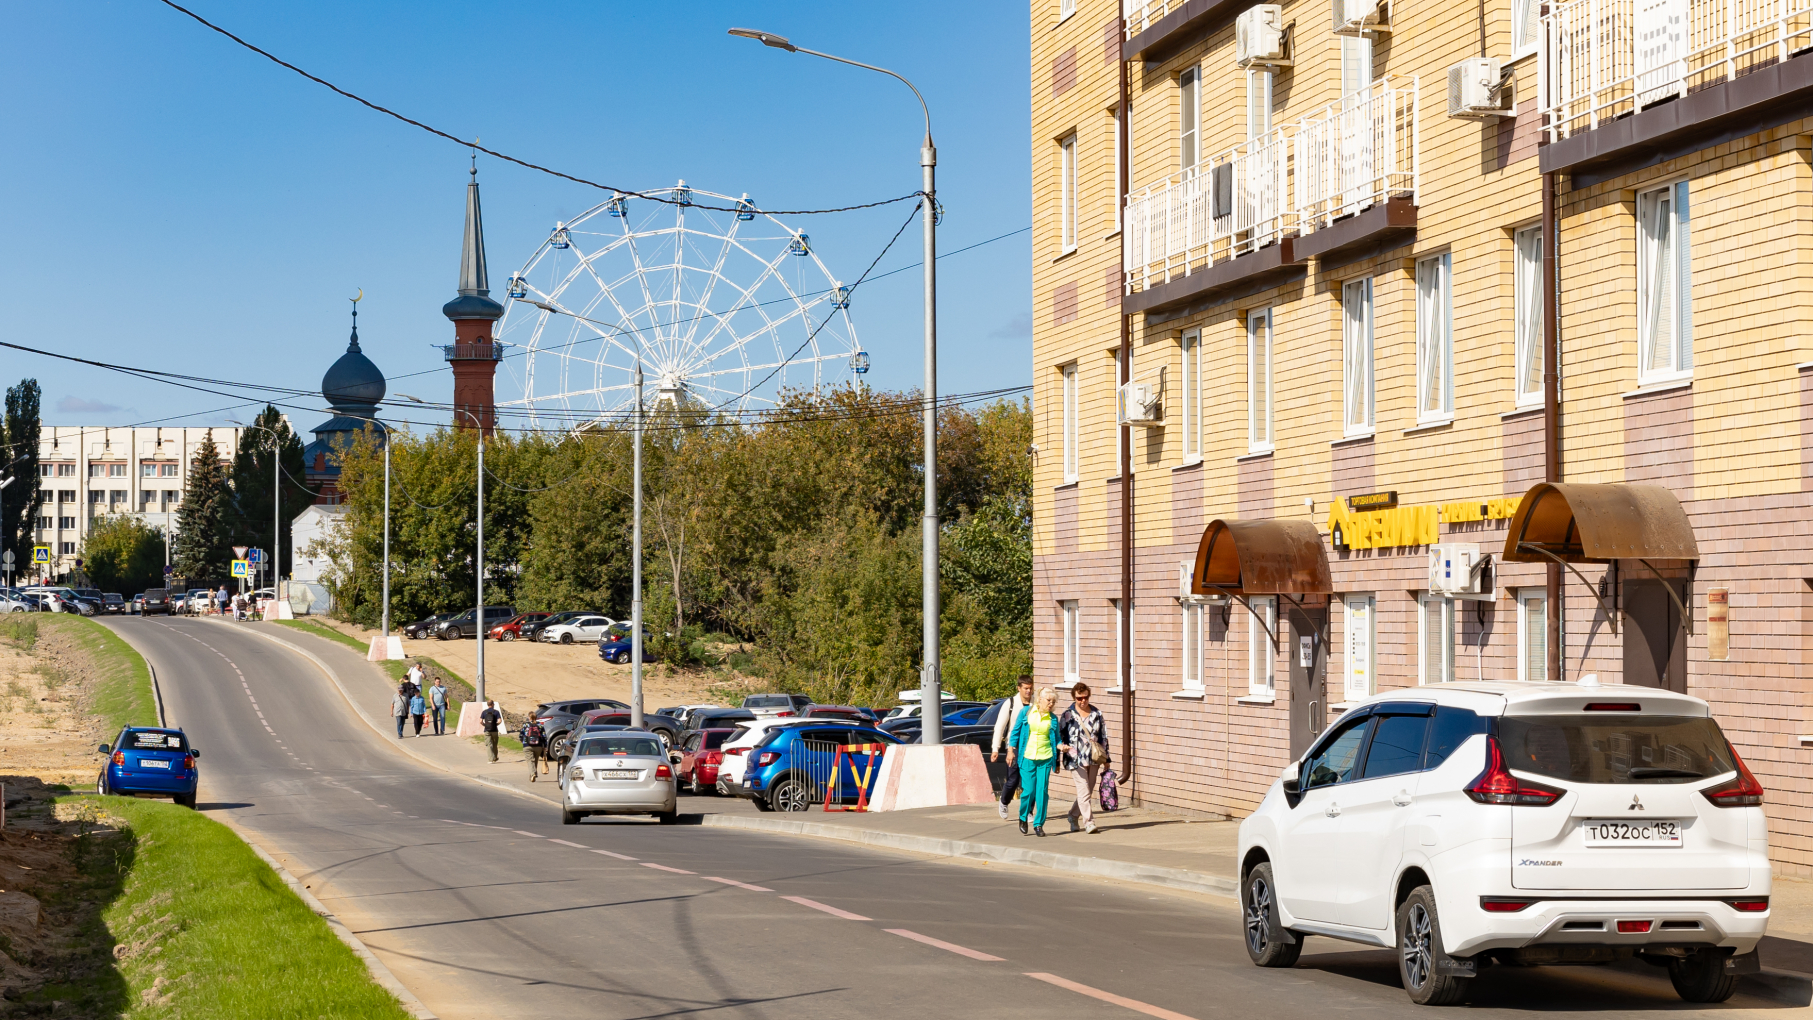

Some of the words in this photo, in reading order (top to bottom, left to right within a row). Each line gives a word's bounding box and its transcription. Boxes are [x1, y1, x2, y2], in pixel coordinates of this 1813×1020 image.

[1349, 505, 1439, 550] ПРЕМИУМ
[1653, 822, 1676, 835] 152
[1518, 859, 1563, 867] XPANDER
